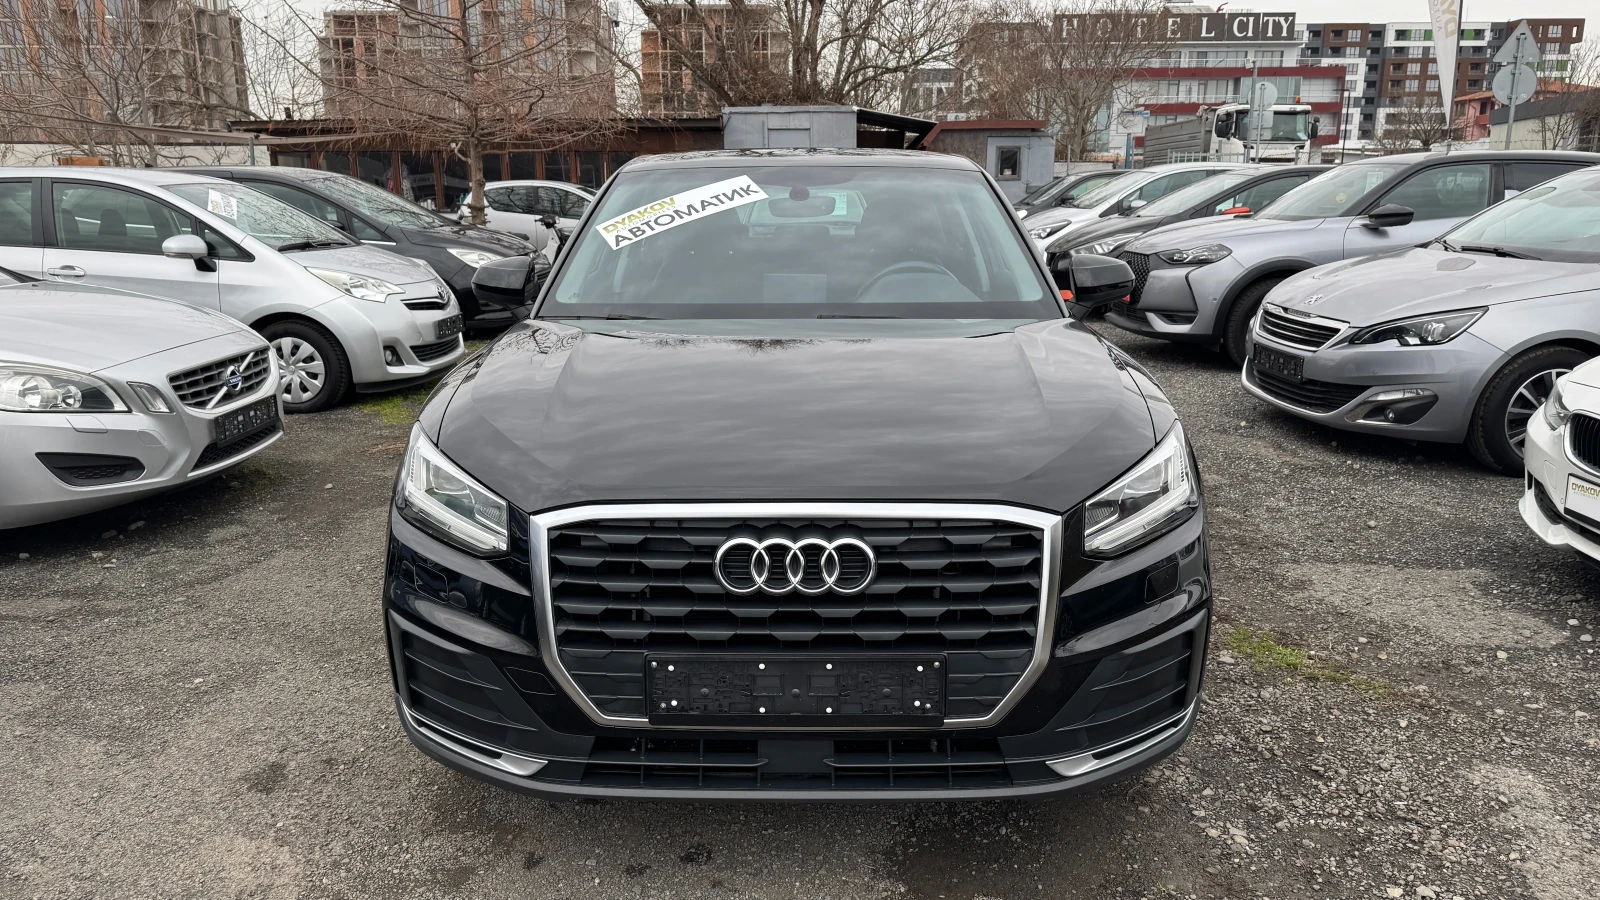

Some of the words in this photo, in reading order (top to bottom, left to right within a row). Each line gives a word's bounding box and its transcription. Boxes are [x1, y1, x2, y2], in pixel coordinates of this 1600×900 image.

[1062, 17, 1215, 38] HOTEL
[1232, 16, 1294, 38] CITY
[602, 197, 676, 234] DYAKOV
[614, 184, 761, 248] АВТОМАТИК
[616, 206, 676, 234] AUTOMOBILES
[1571, 482, 1600, 497] DYAKOV
